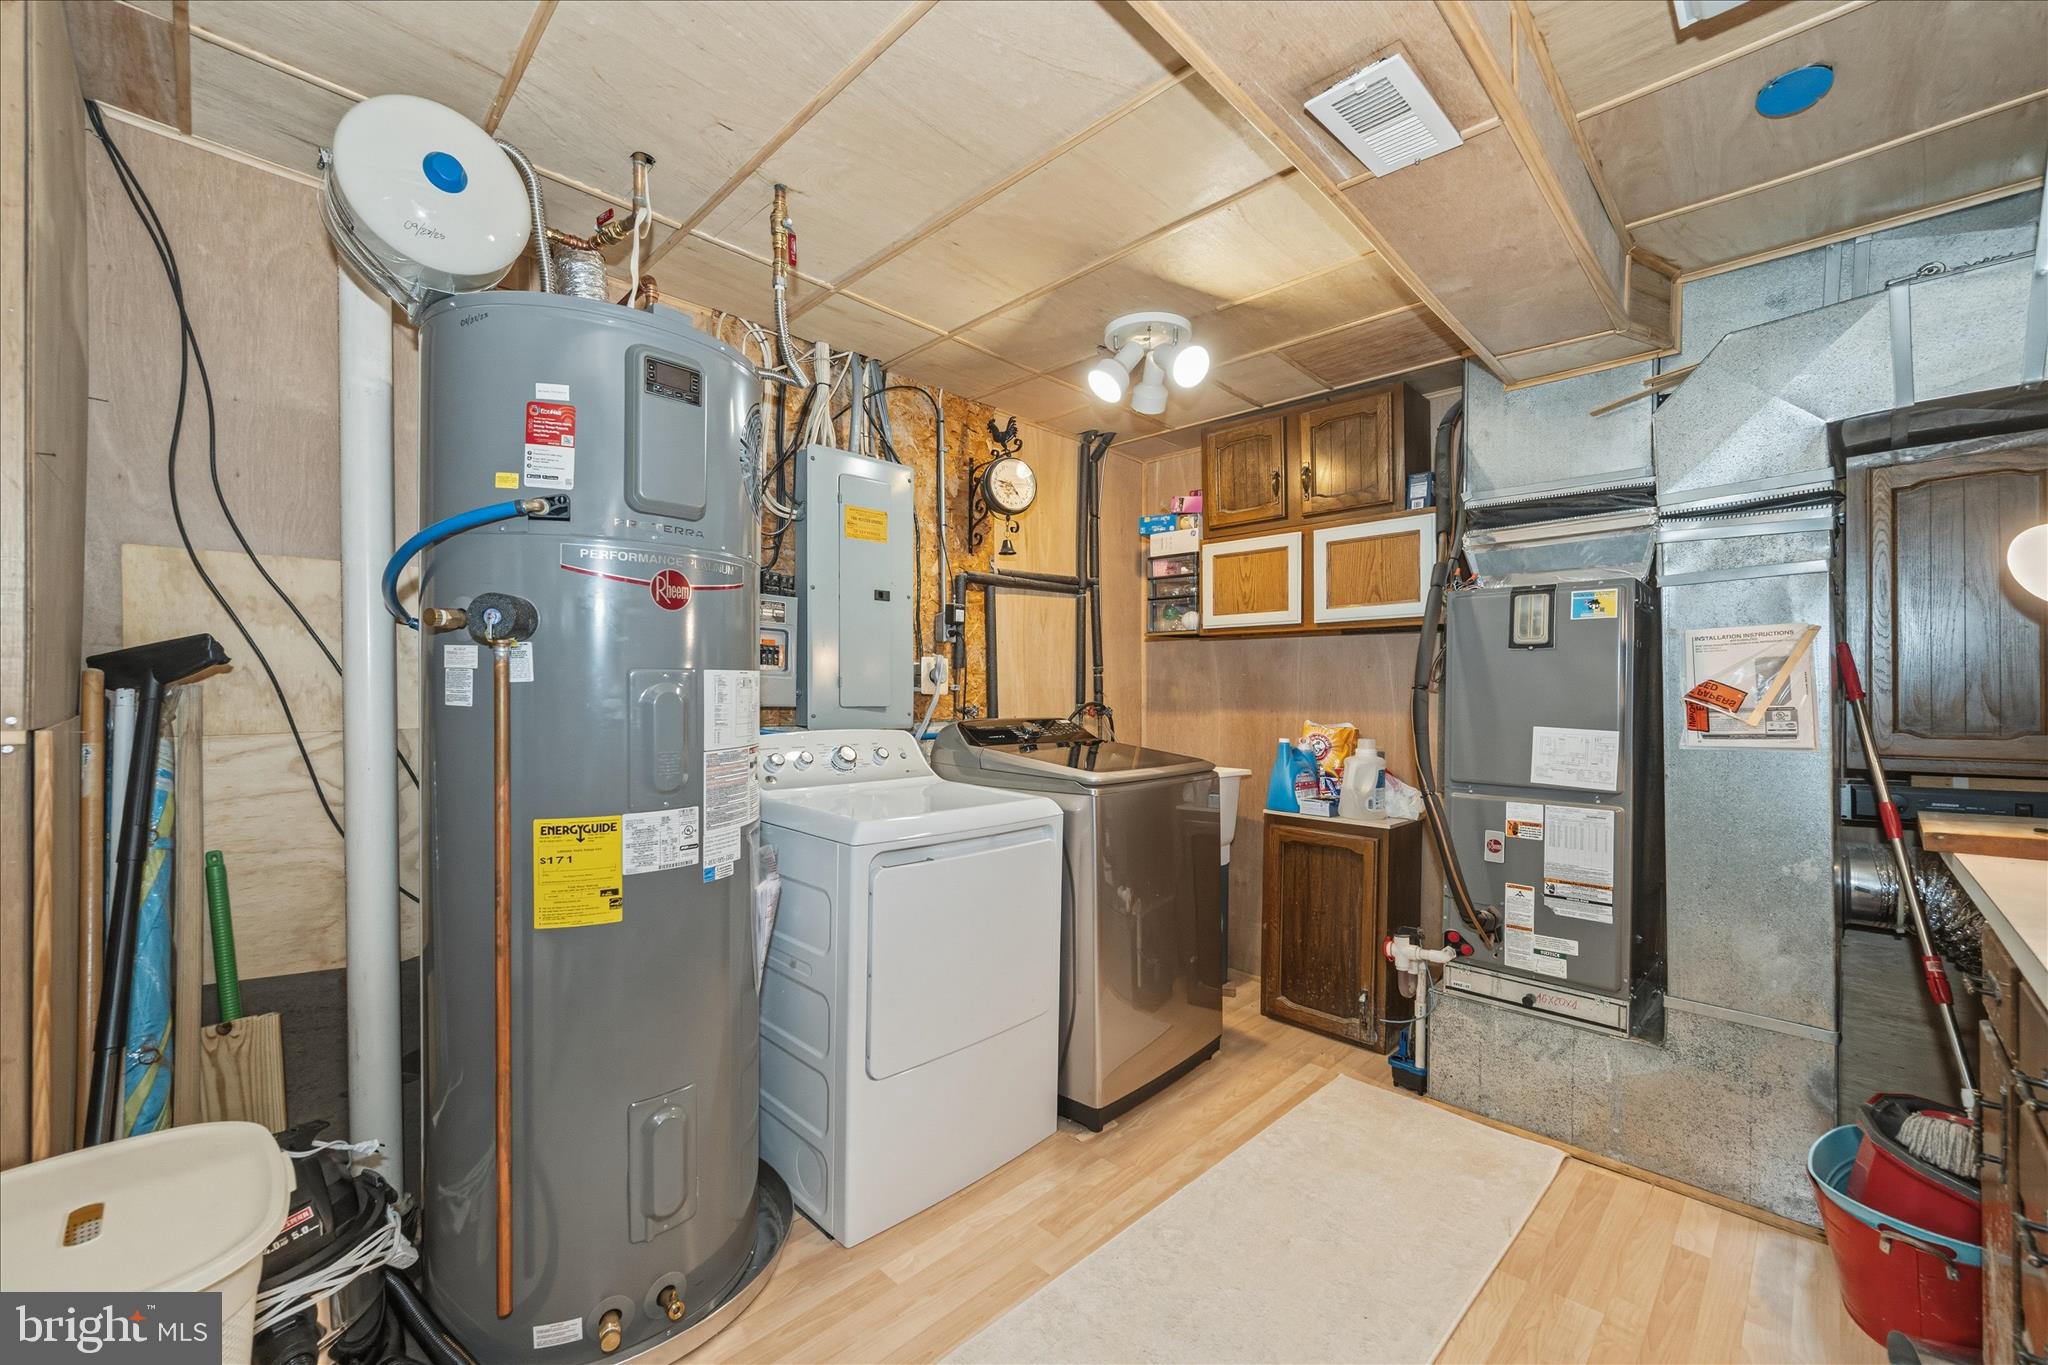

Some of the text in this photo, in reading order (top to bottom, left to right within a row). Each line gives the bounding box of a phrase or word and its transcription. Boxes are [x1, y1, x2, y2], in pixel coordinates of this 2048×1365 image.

[580, 549, 684, 567] PERFORMANCE
[655, 569, 690, 605] Rheem
[1694, 630, 1794, 641] INSTALLATION INSTRUCTIONS
[541, 822, 618, 836] ENERGYGUIDE
